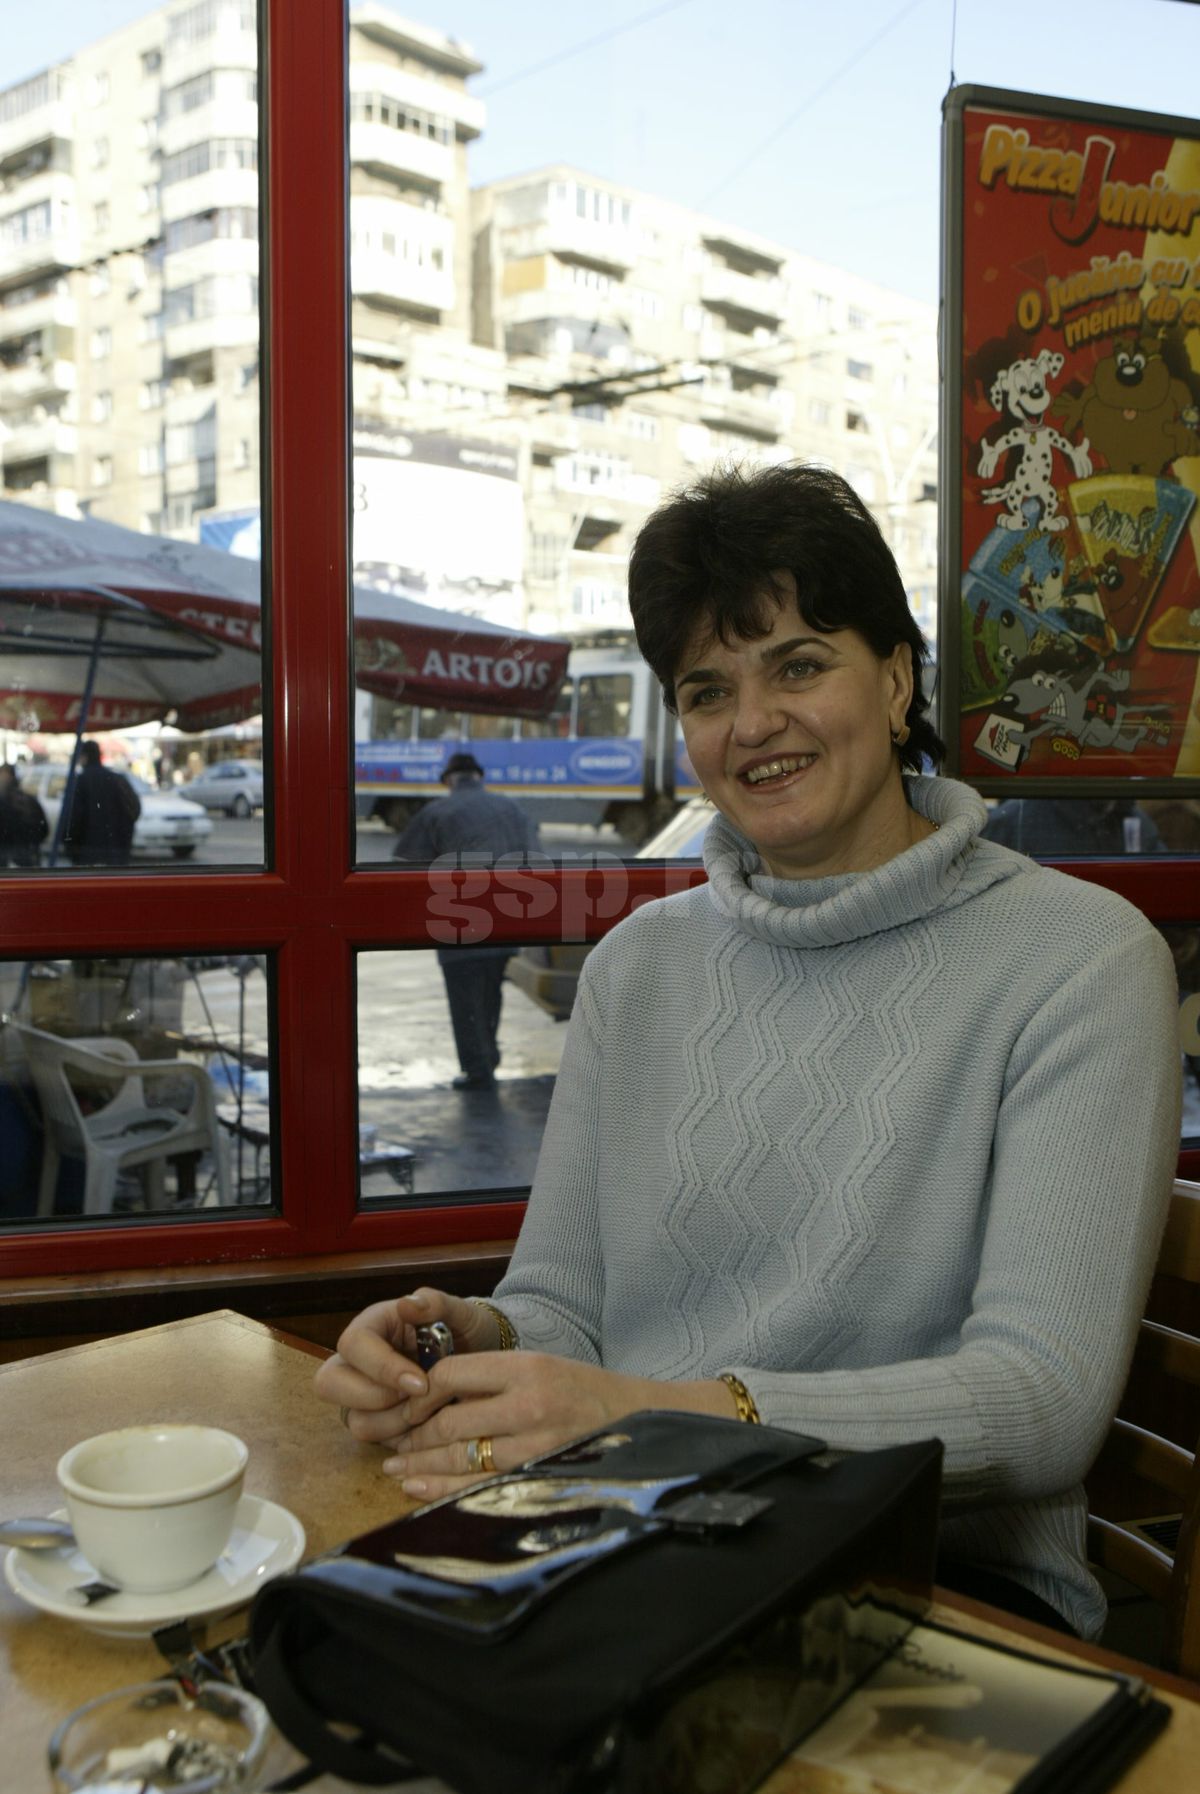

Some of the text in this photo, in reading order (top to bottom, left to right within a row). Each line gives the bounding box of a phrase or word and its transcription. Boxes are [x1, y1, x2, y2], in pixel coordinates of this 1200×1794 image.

[979, 125, 1084, 196] Pizza
[1017, 288, 1043, 332] O
[1150, 256, 1191, 289] cu
[1065, 290, 1143, 350] meniu
[1146, 285, 1182, 325] de
[421, 650, 551, 690] ARTOIS
